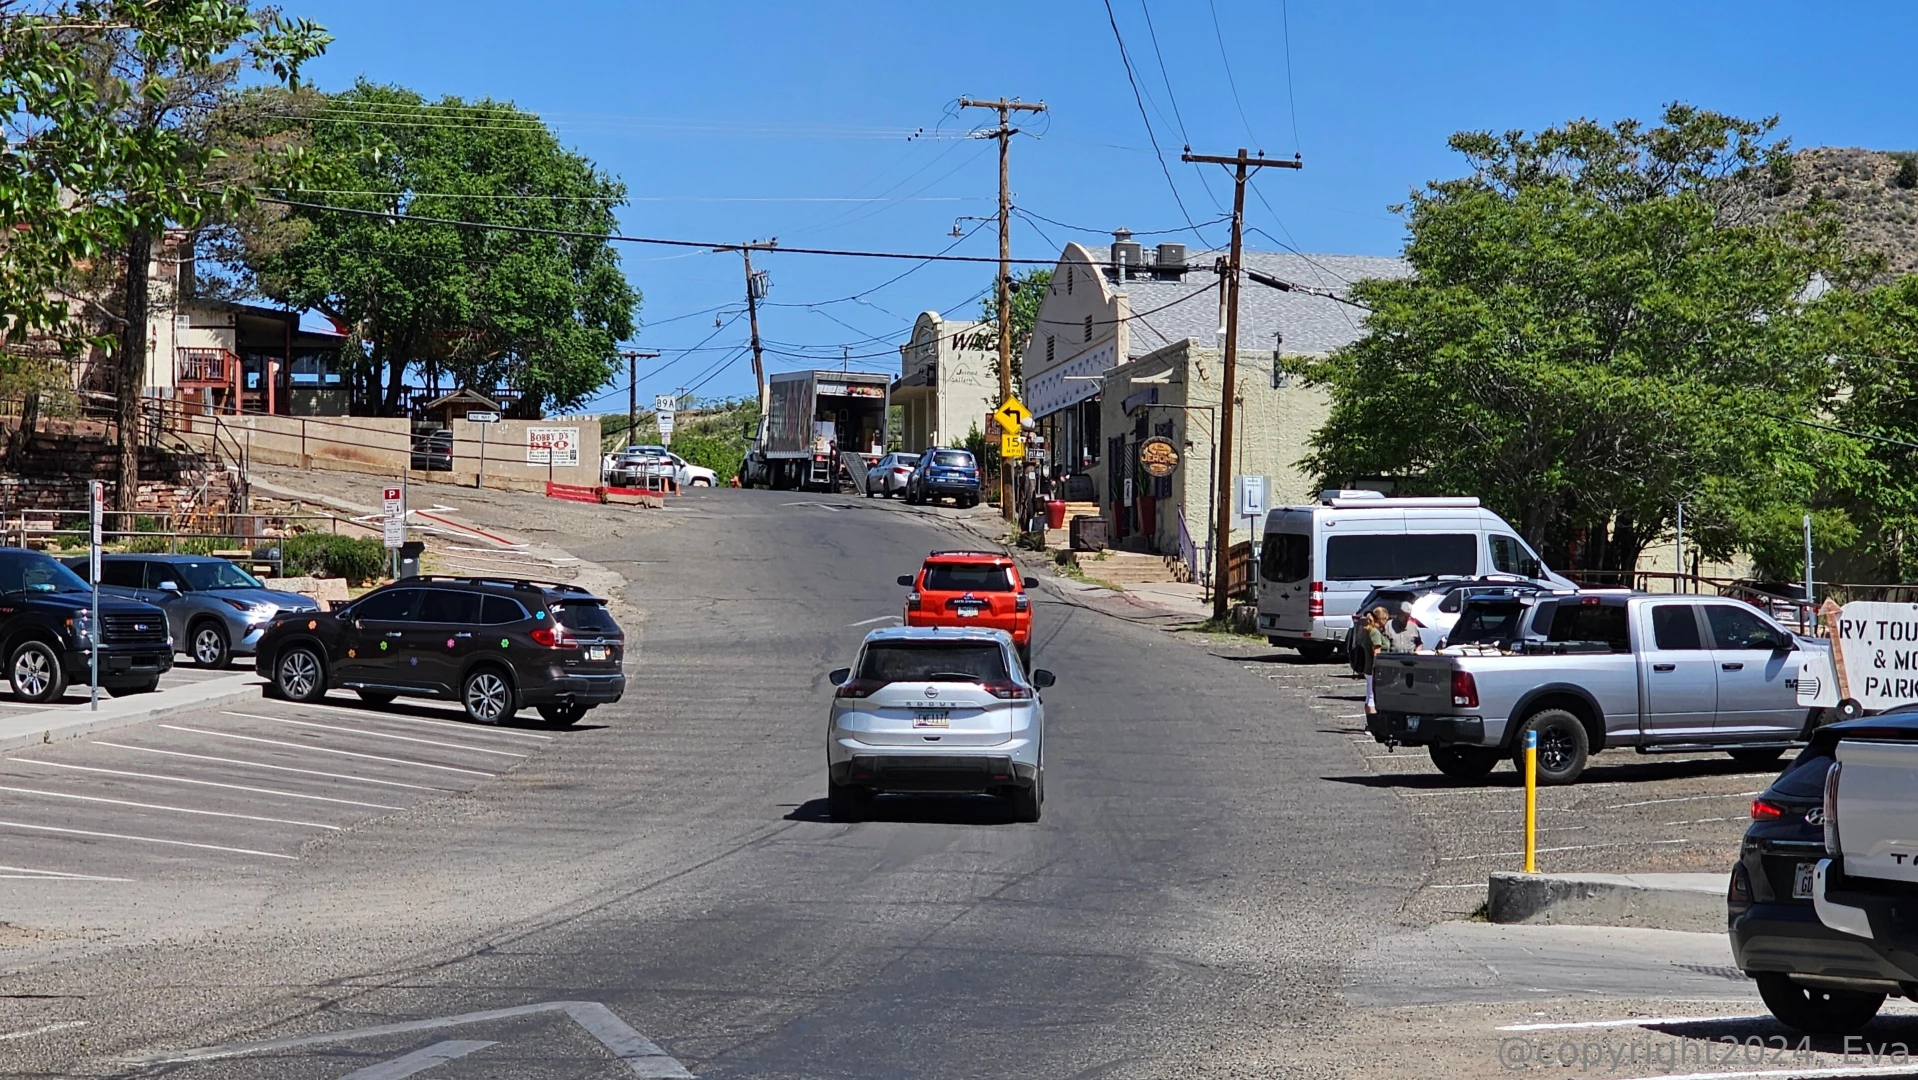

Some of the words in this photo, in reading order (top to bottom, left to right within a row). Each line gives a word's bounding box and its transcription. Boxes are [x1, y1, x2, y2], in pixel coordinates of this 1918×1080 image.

[656, 398, 675, 408] 89A
[530, 432, 556, 441] BOBBY
[1006, 437, 1020, 447] 15
[1141, 454, 1179, 465] JEROME
[388, 490, 396, 499] P
[1873, 649, 1886, 668] &
